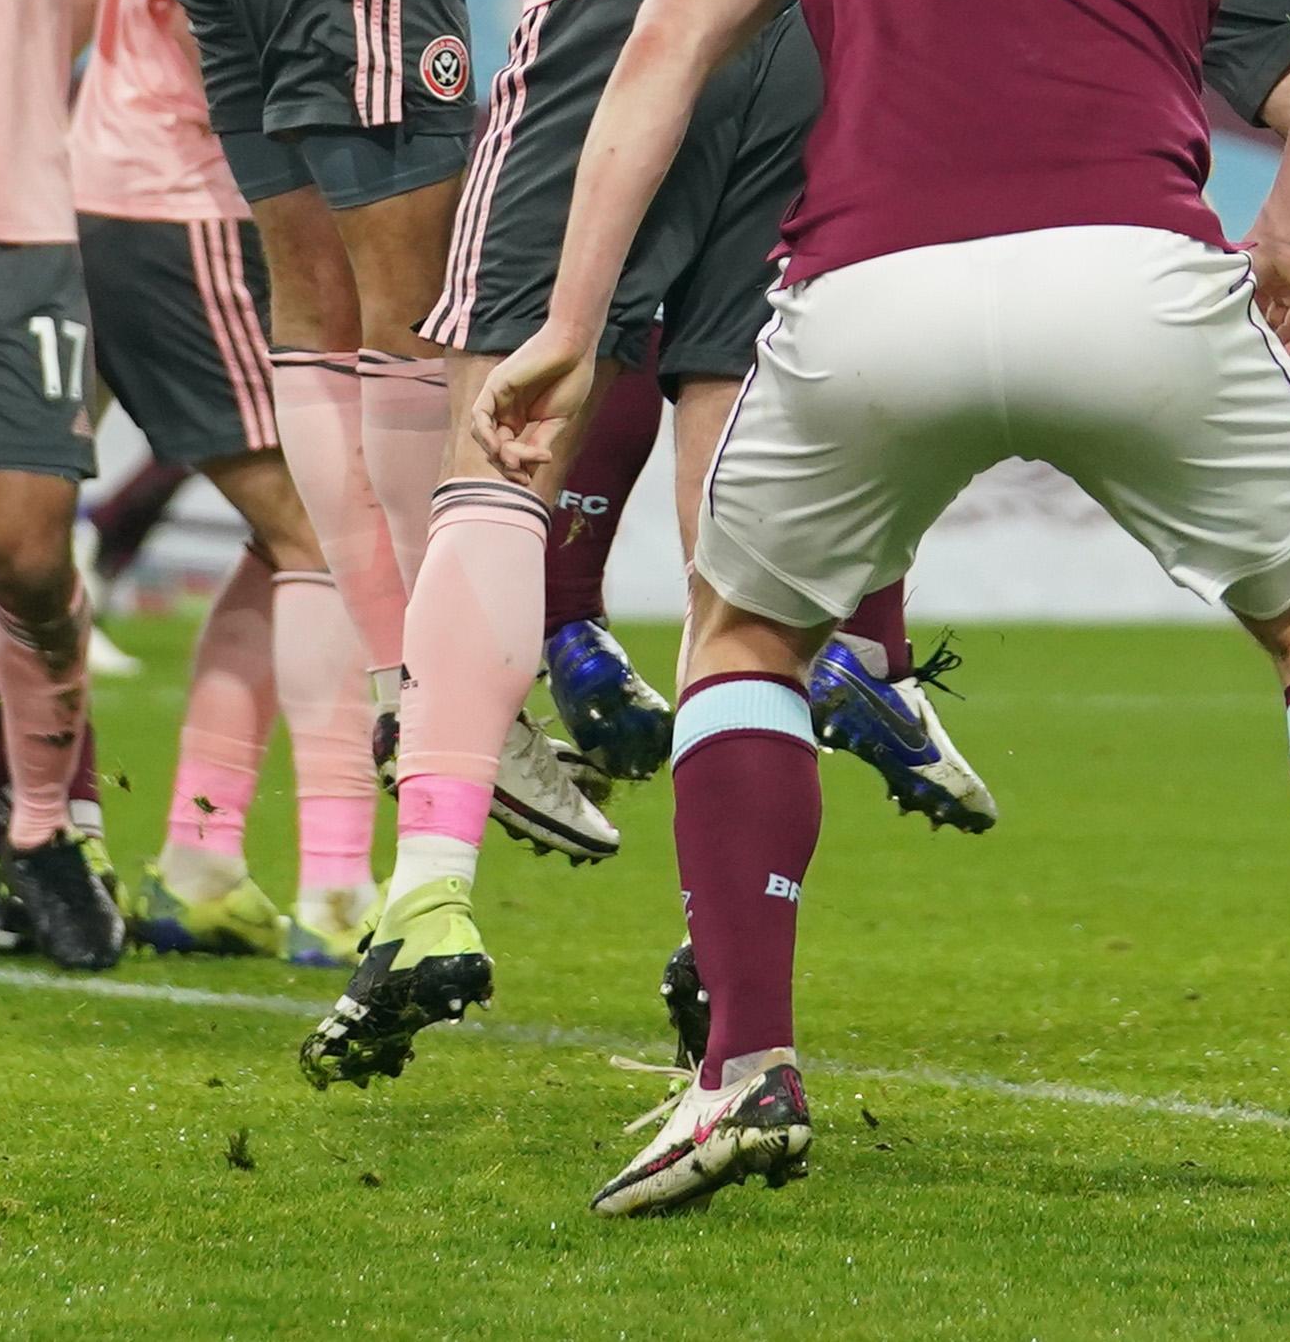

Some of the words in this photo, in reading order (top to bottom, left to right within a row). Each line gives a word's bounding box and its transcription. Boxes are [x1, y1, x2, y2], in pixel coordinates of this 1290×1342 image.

[28, 315, 88, 401] 17
[557, 489, 609, 515] FC
[764, 872, 802, 903] BF
